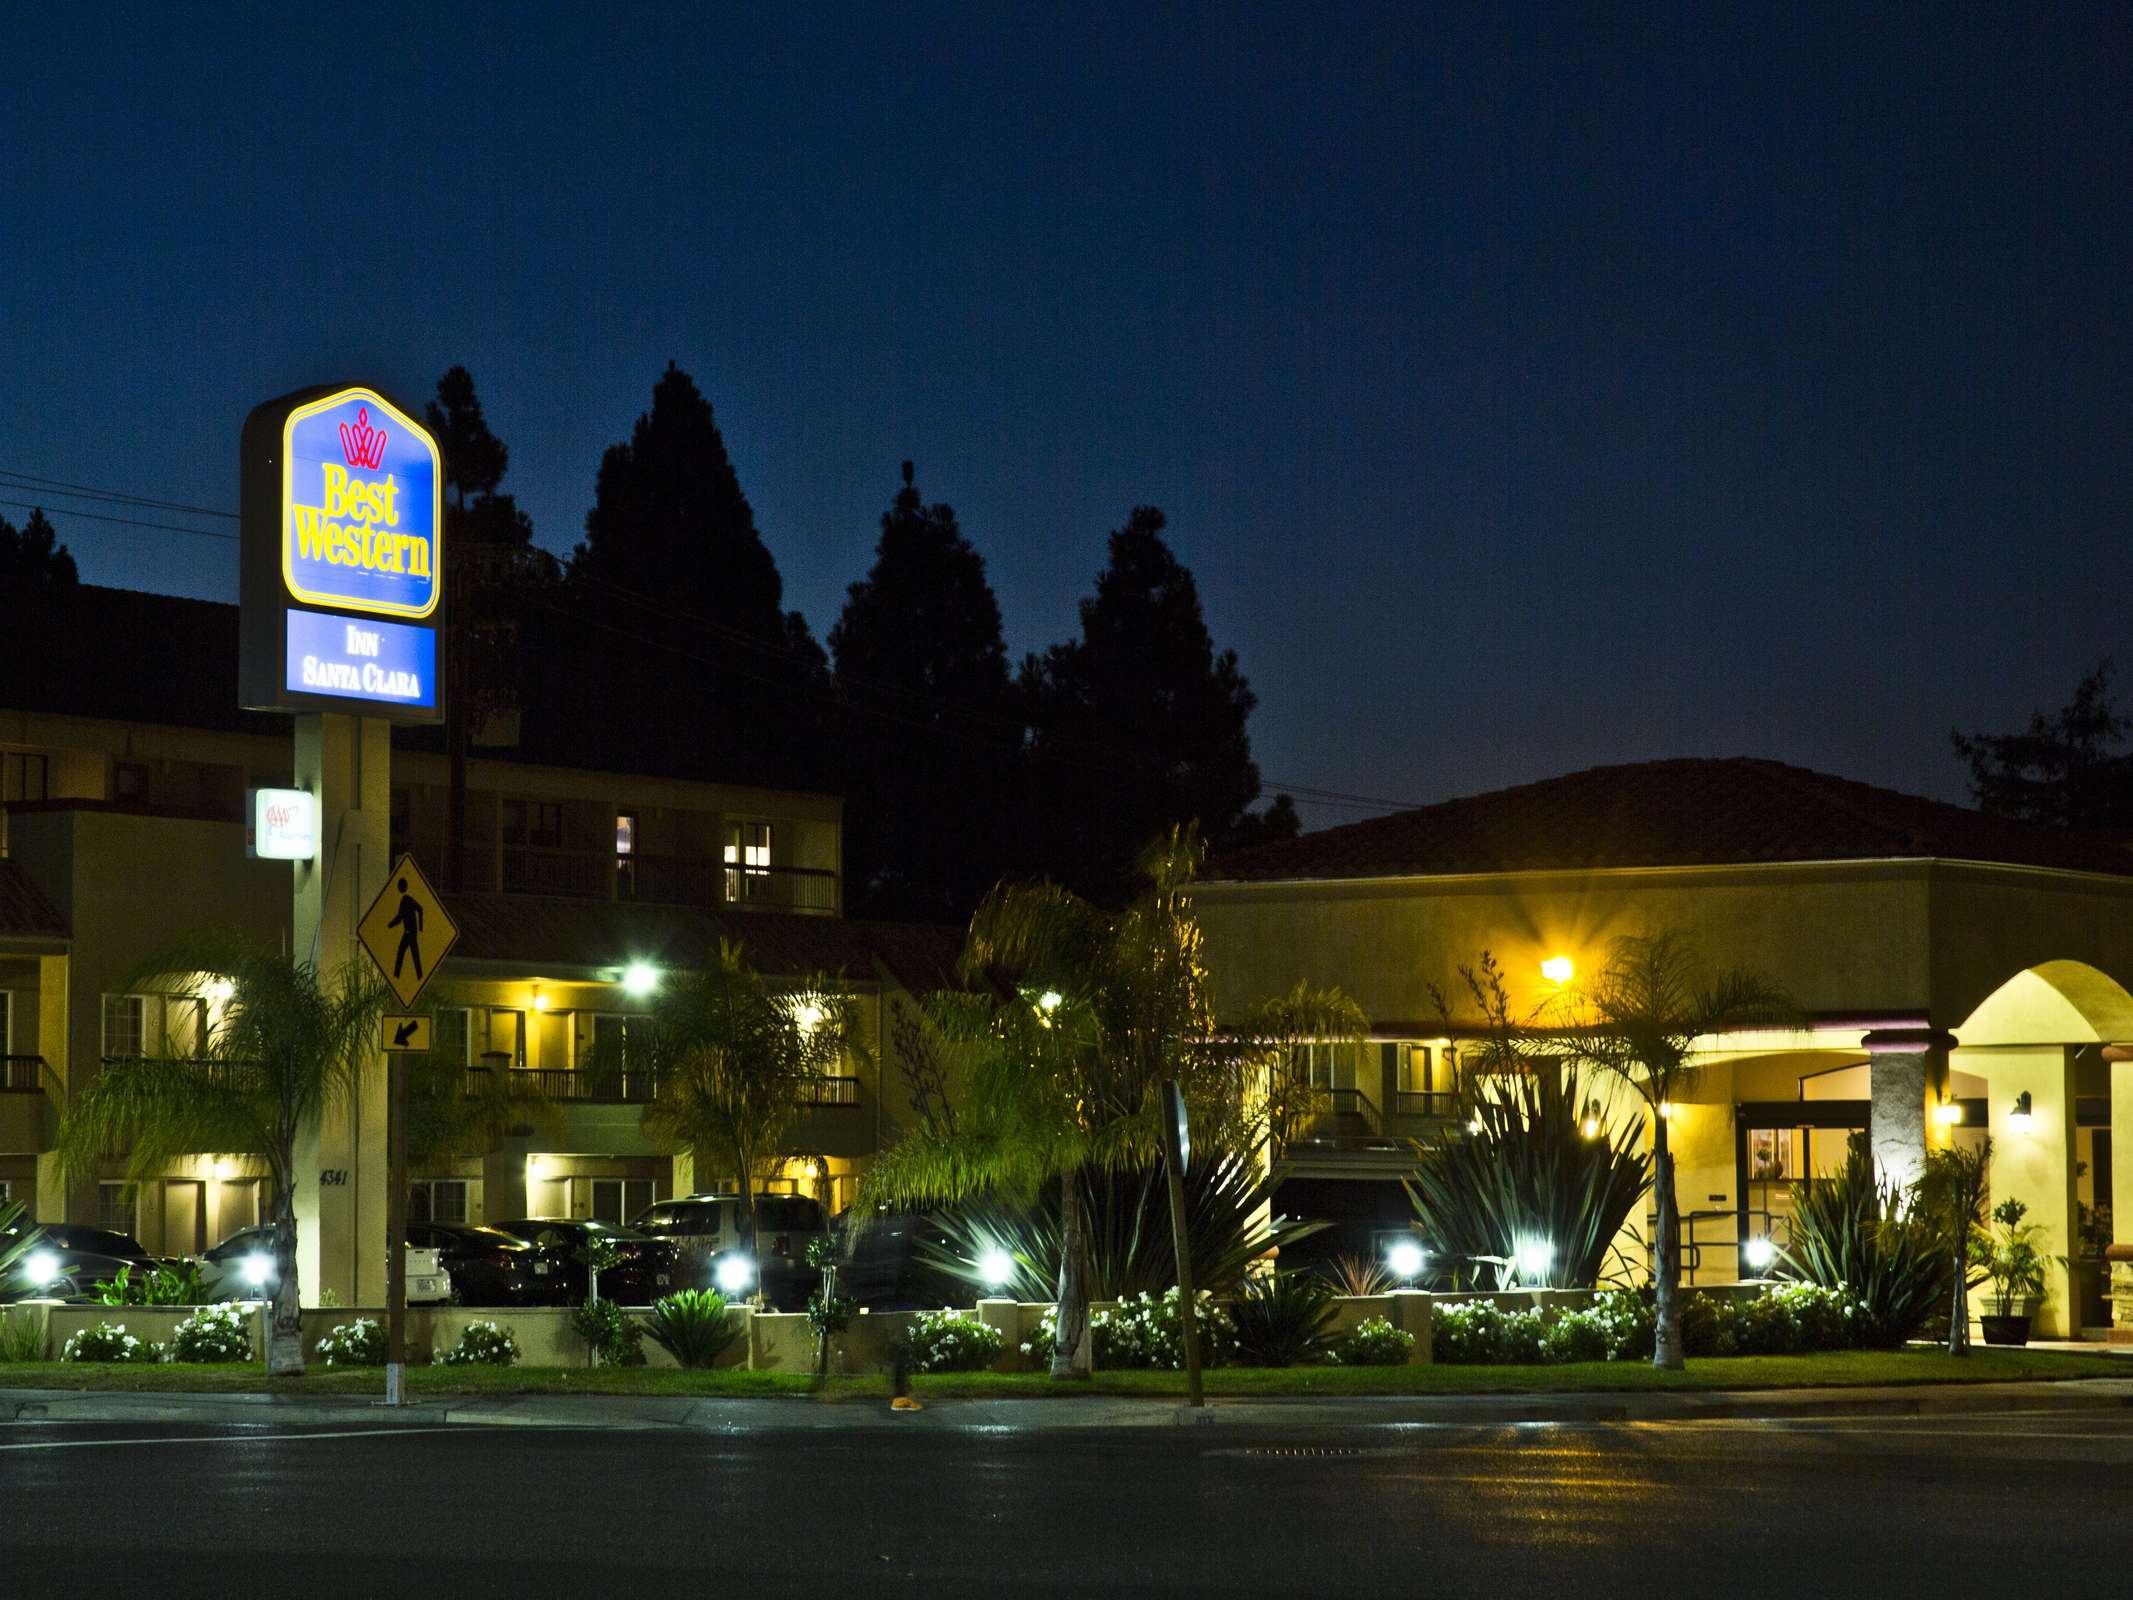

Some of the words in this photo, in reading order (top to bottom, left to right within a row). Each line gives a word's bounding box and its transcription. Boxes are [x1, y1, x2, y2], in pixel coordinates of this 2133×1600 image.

[322, 462, 399, 527] Best
[293, 503, 431, 578] Western
[346, 624, 379, 657] INN
[303, 655, 361, 690] SANTA
[362, 663, 420, 698] CLARA
